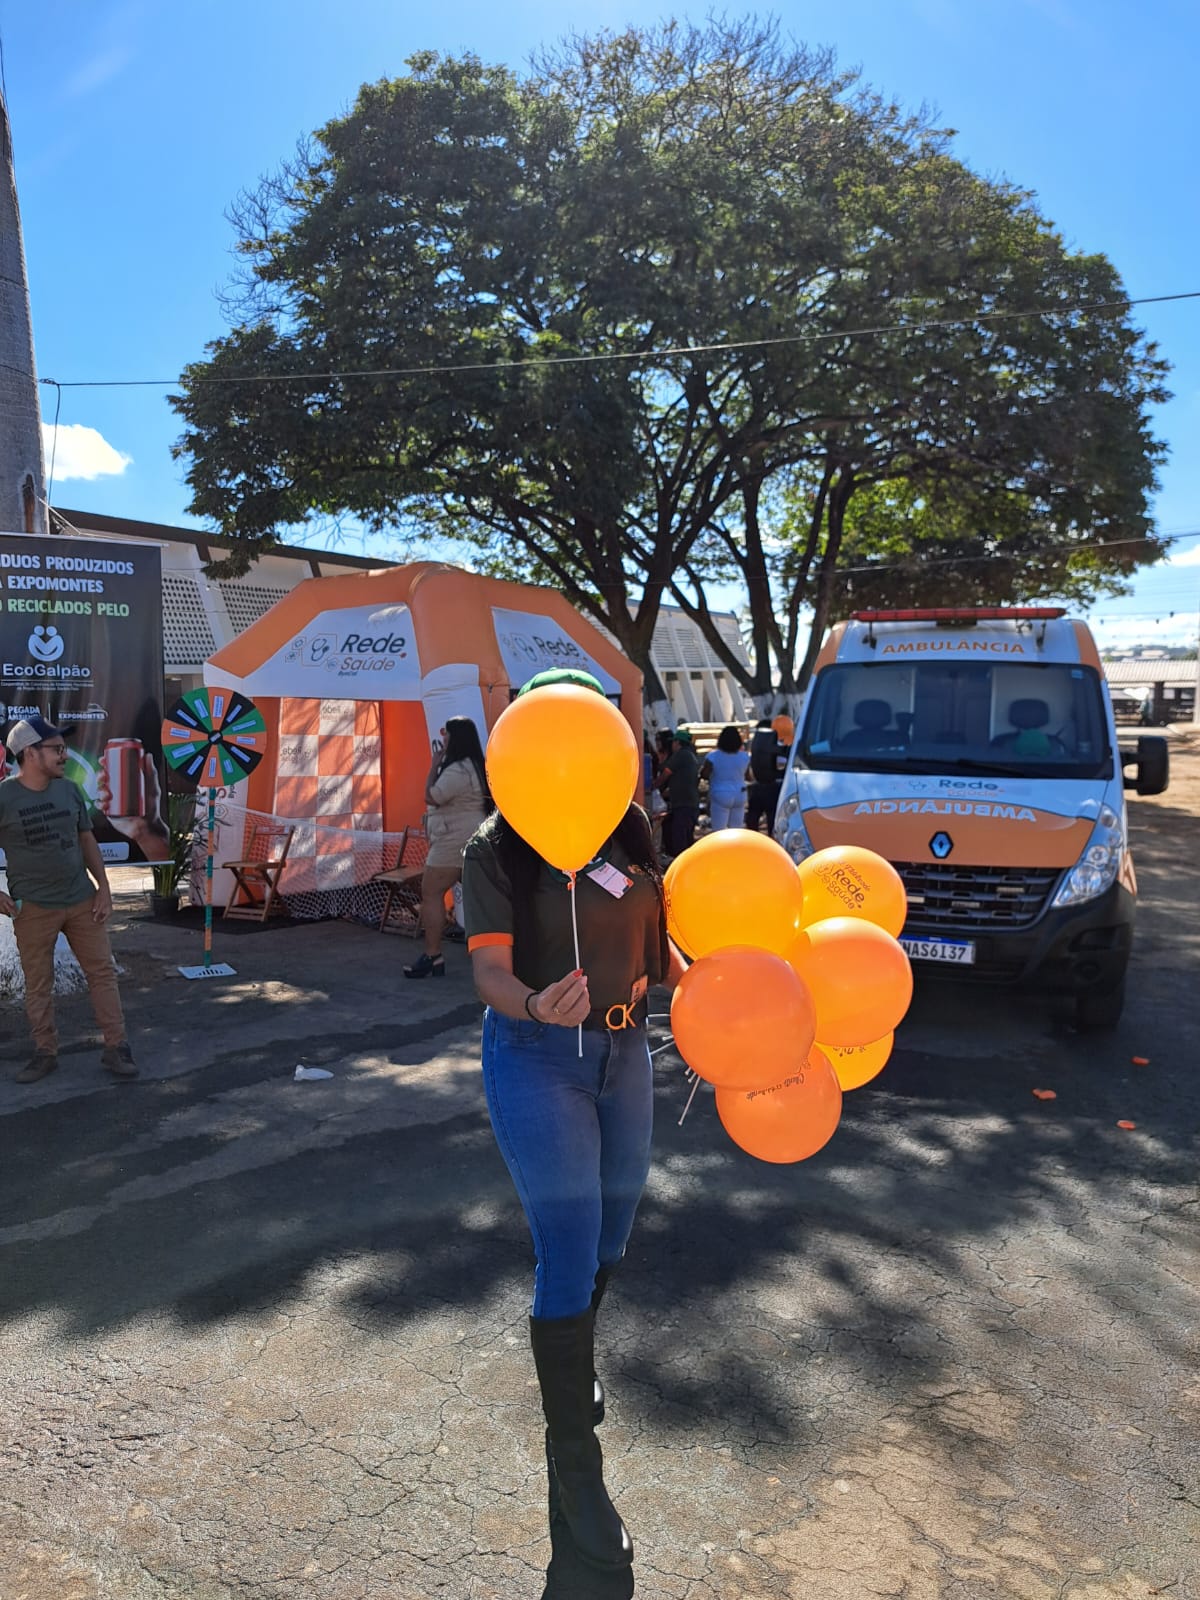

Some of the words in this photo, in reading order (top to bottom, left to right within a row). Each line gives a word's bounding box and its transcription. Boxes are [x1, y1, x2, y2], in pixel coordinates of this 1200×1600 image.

[0, 553, 40, 569] DUOS
[46, 556, 134, 575] PRODUZIDOS
[8, 575, 104, 593] EXPOMONTES
[7, 598, 92, 615] RECICLADOS
[97, 602, 130, 616] PELO
[340, 632, 406, 654] Rede
[531, 635, 580, 658] Rede
[882, 638, 1026, 655] AMBULÂNCIA
[3, 663, 91, 679] EcoGalpão
[340, 656, 396, 671] Saúde
[8, 706, 40, 715] PEGADA
[58, 712, 106, 720] EXPOMONTES
[939, 778, 999, 791] Rede
[832, 868, 865, 902] Rede
